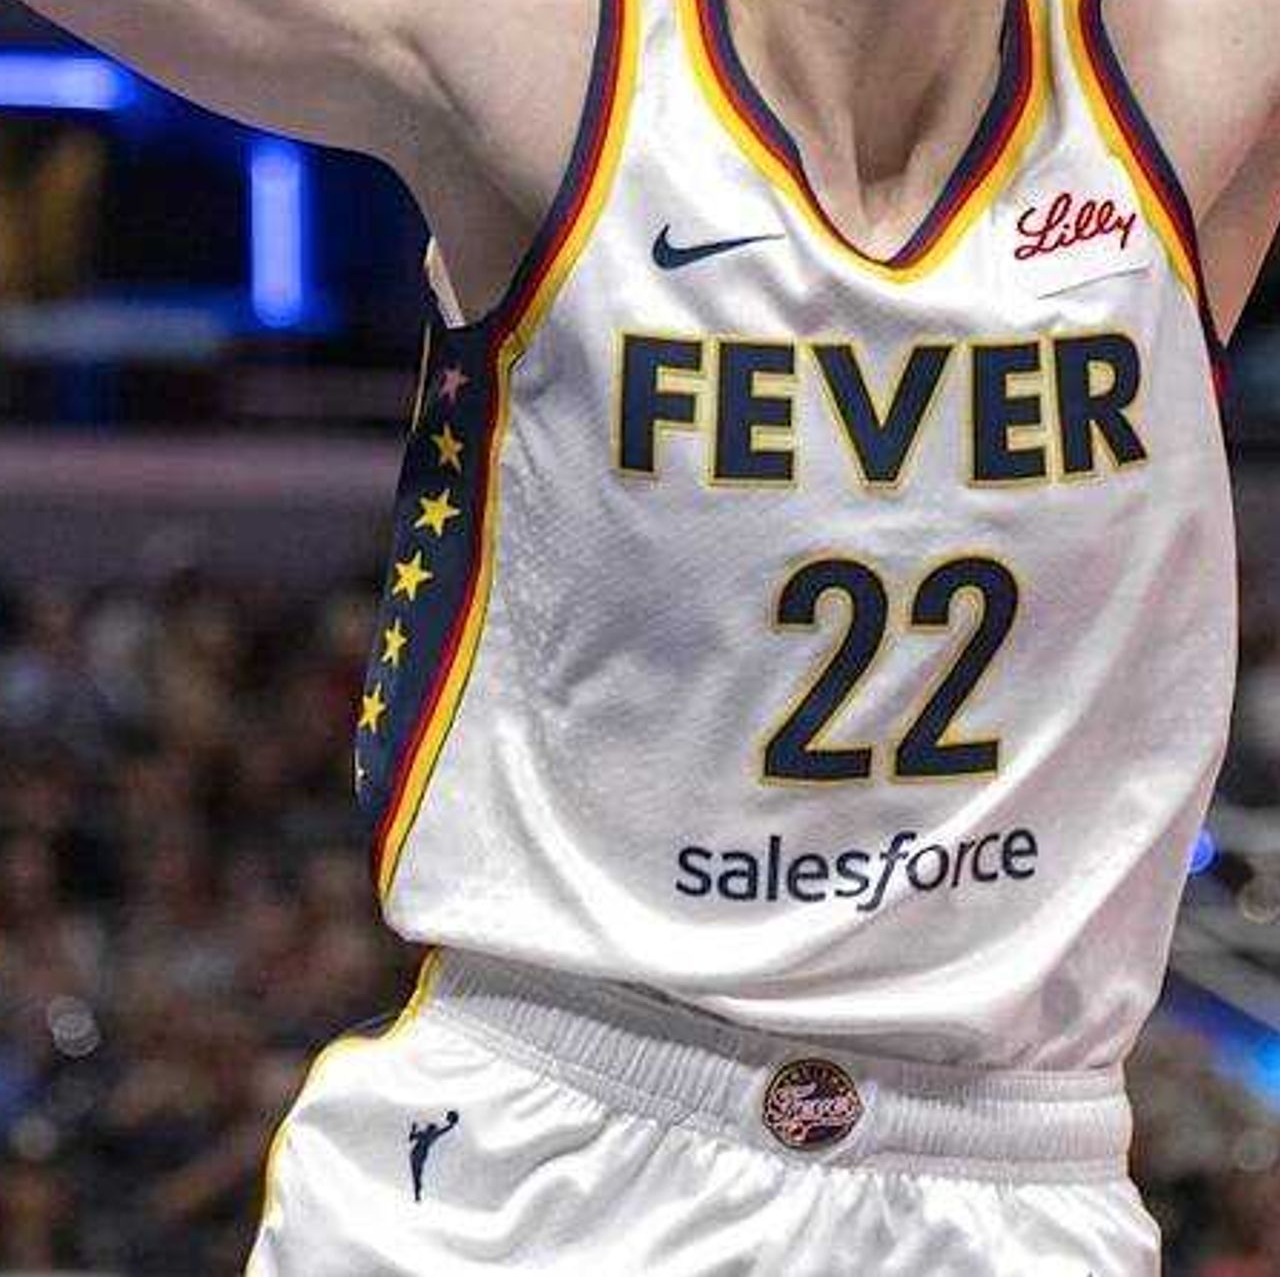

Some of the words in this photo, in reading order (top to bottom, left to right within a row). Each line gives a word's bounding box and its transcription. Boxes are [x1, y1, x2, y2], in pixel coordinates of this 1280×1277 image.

[1013, 192, 1137, 260] Lilly
[615, 331, 1149, 493] FEVER
[759, 548, 1022, 786] 22
[675, 827, 1039, 912] salesforce
